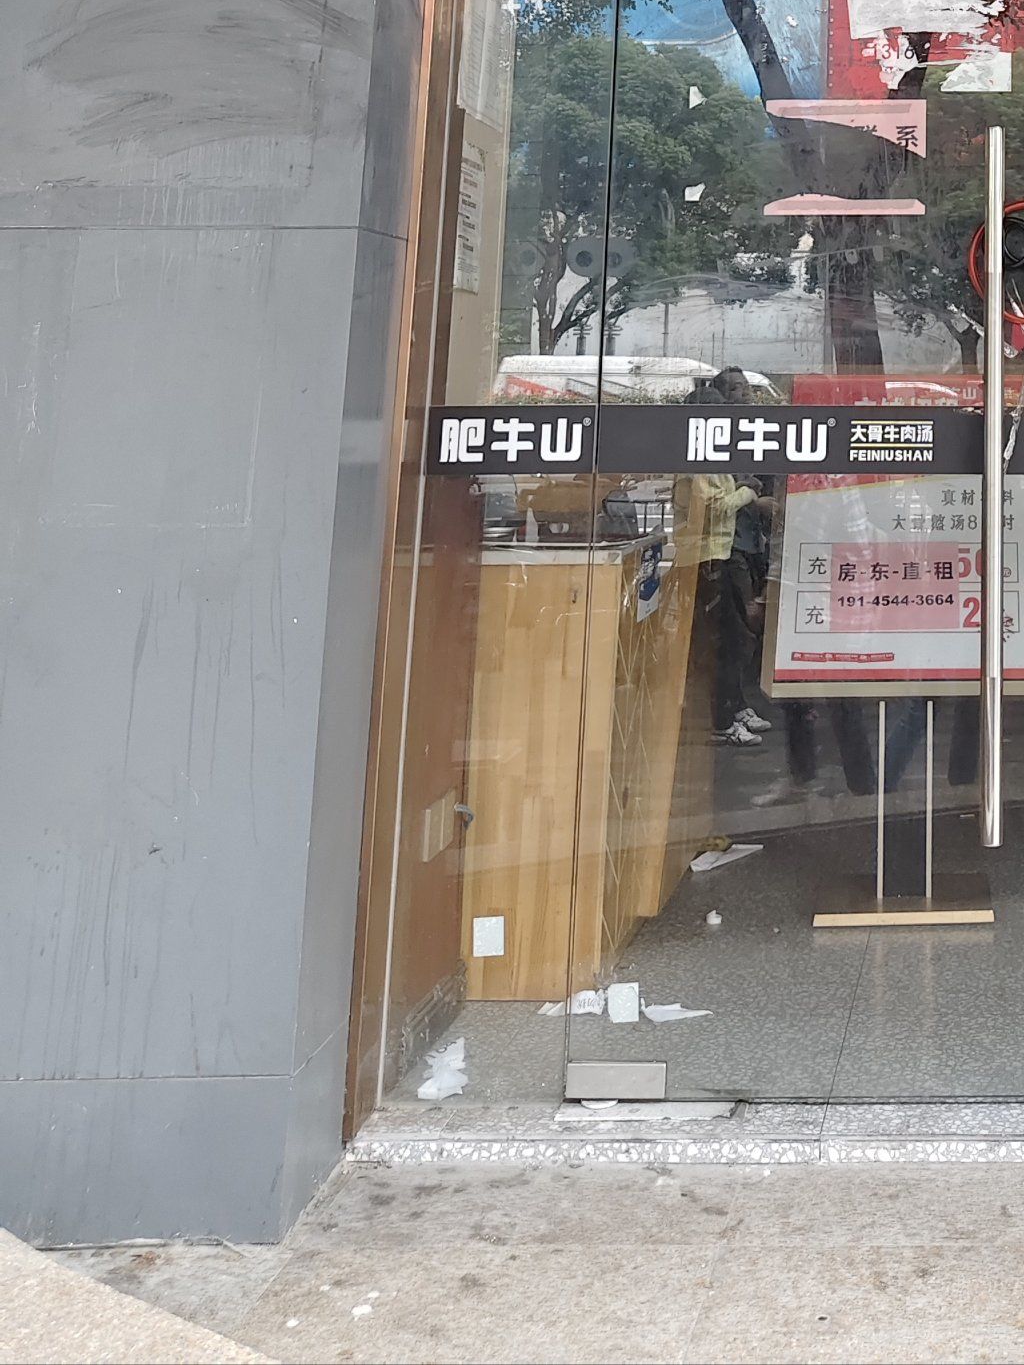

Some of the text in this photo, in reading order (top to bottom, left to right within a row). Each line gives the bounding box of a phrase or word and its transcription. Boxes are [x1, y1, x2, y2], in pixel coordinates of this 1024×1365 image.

[439, 418, 583, 463] 肥牛山
[687, 418, 828, 462] 肥牛山
[850, 425, 933, 443] 大骨牛肉汤
[850, 449, 933, 462] FEINIUSHAN
[808, 557, 827, 576] 充
[838, 562, 954, 581] 房-东-直-租
[837, 594, 954, 607] 191-4544-3664
[805, 606, 825, 625] 充
